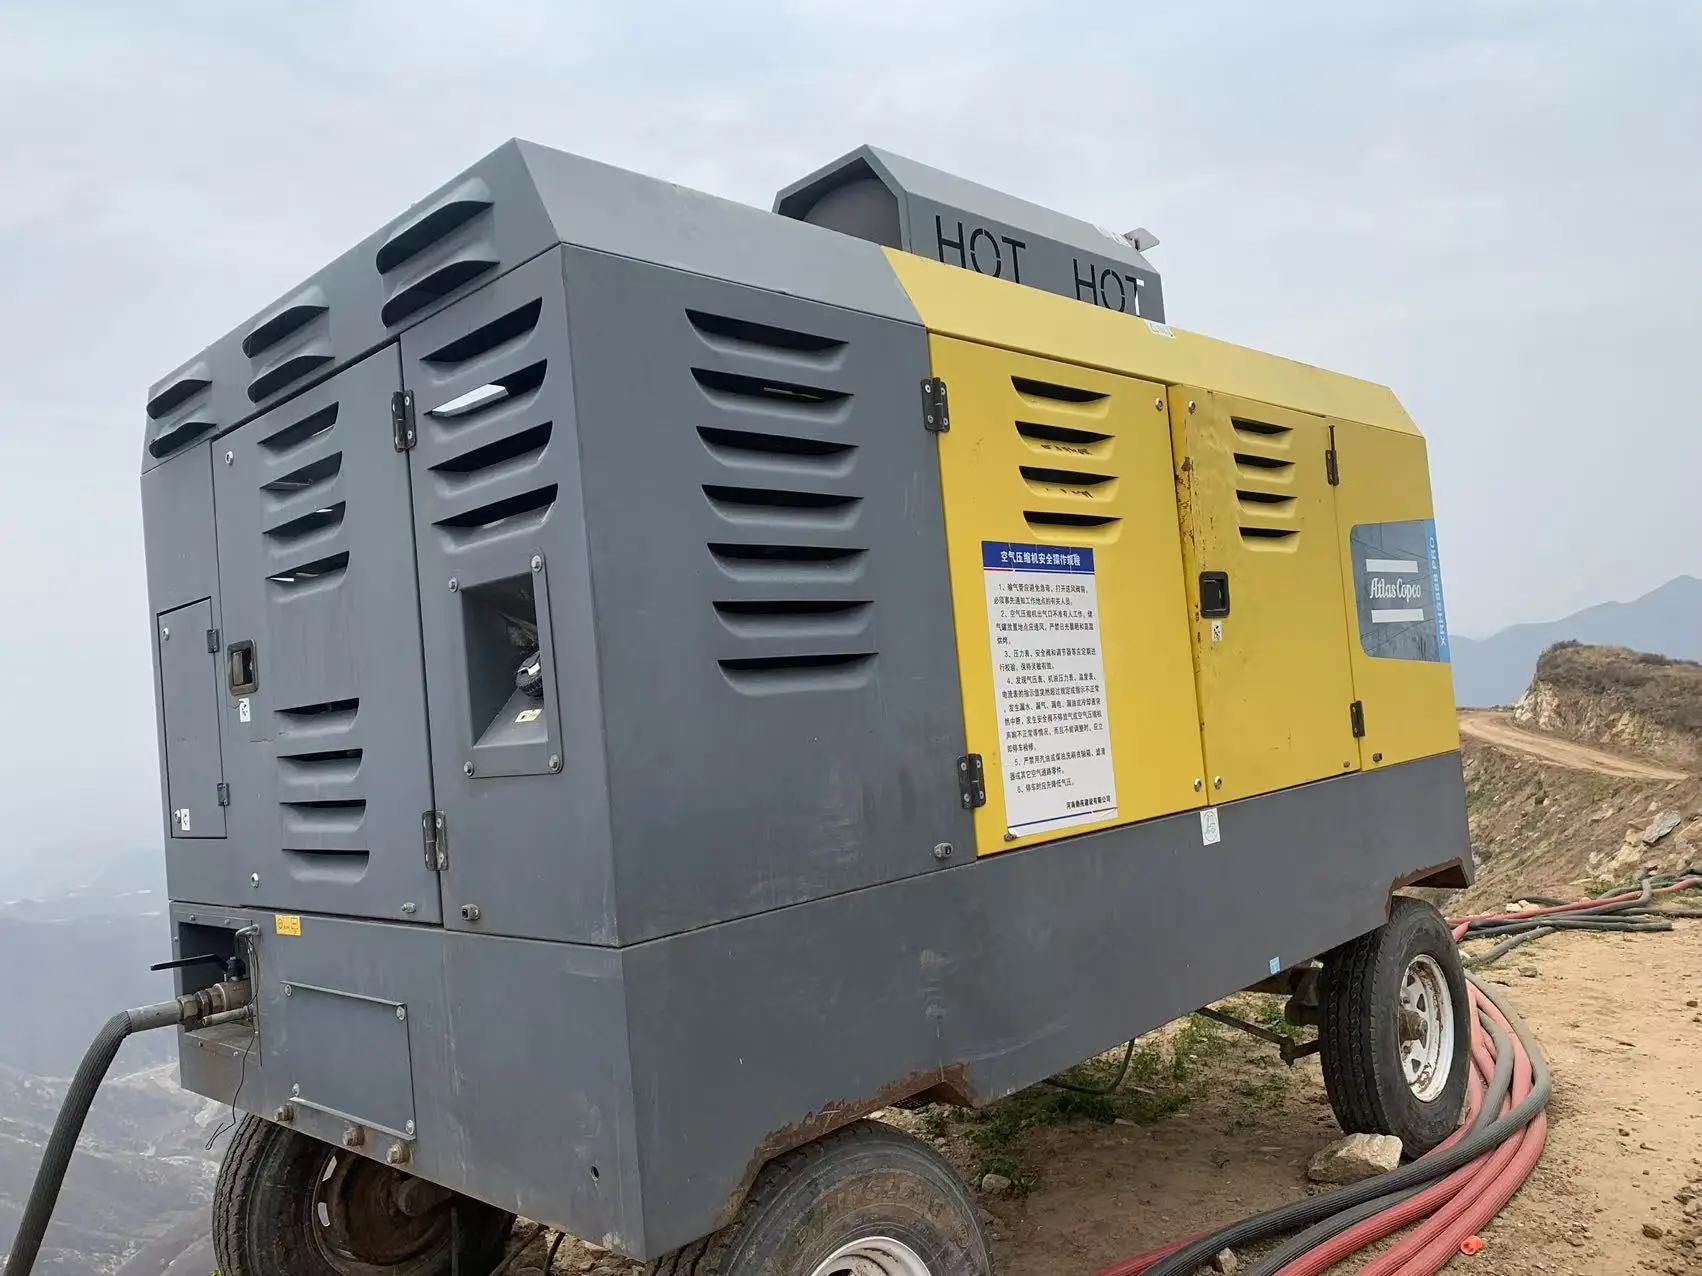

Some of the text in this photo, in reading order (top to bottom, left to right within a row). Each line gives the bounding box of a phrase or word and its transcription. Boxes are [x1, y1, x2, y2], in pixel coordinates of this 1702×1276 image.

[935, 215, 1145, 316] HOT HOT
[1000, 550, 1081, 566] 空气压缩机安全操作规程
[1369, 578, 1422, 603] Atlas Copco
